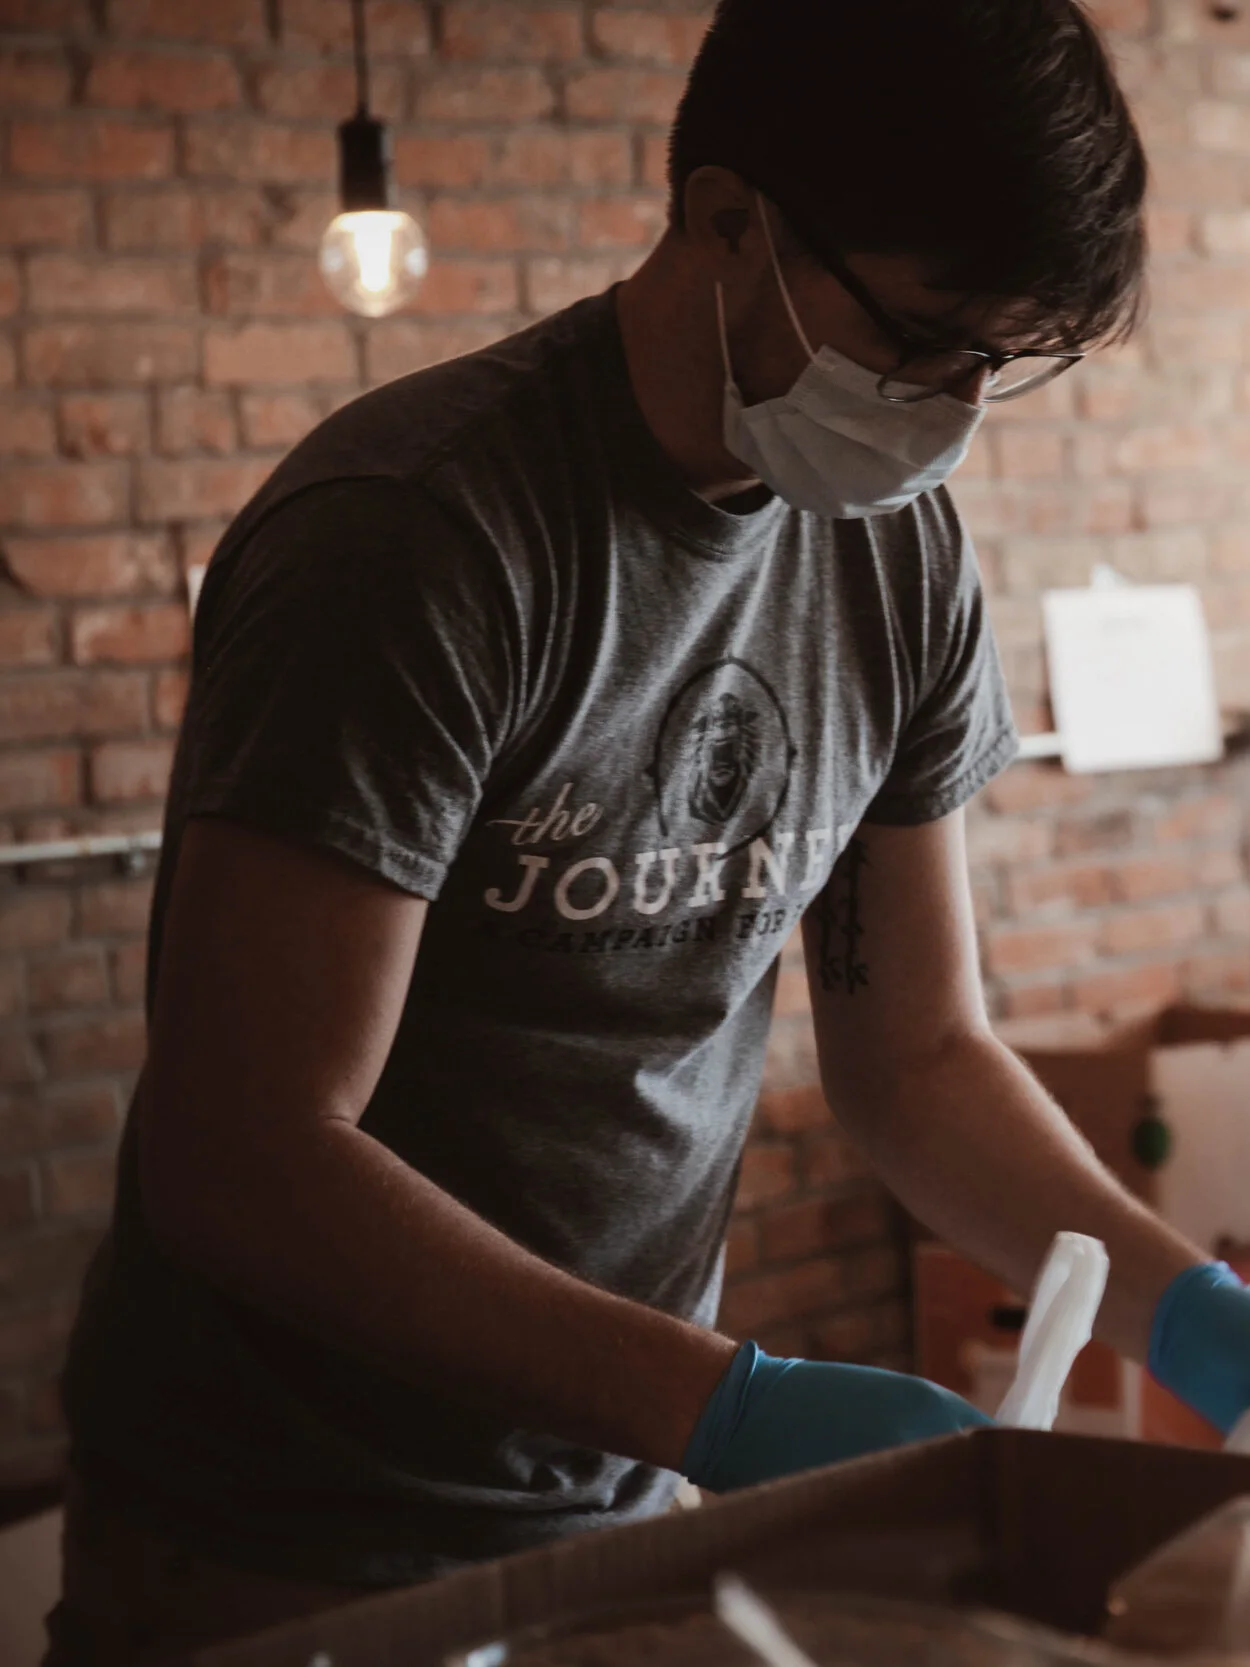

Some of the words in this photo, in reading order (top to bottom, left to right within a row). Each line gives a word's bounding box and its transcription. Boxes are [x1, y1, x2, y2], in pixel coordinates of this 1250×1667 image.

[485, 782, 602, 845] the
[484, 824, 852, 920] JOURNE
[516, 915, 715, 953] CAMPAIGN
[736, 908, 787, 940] FOR
